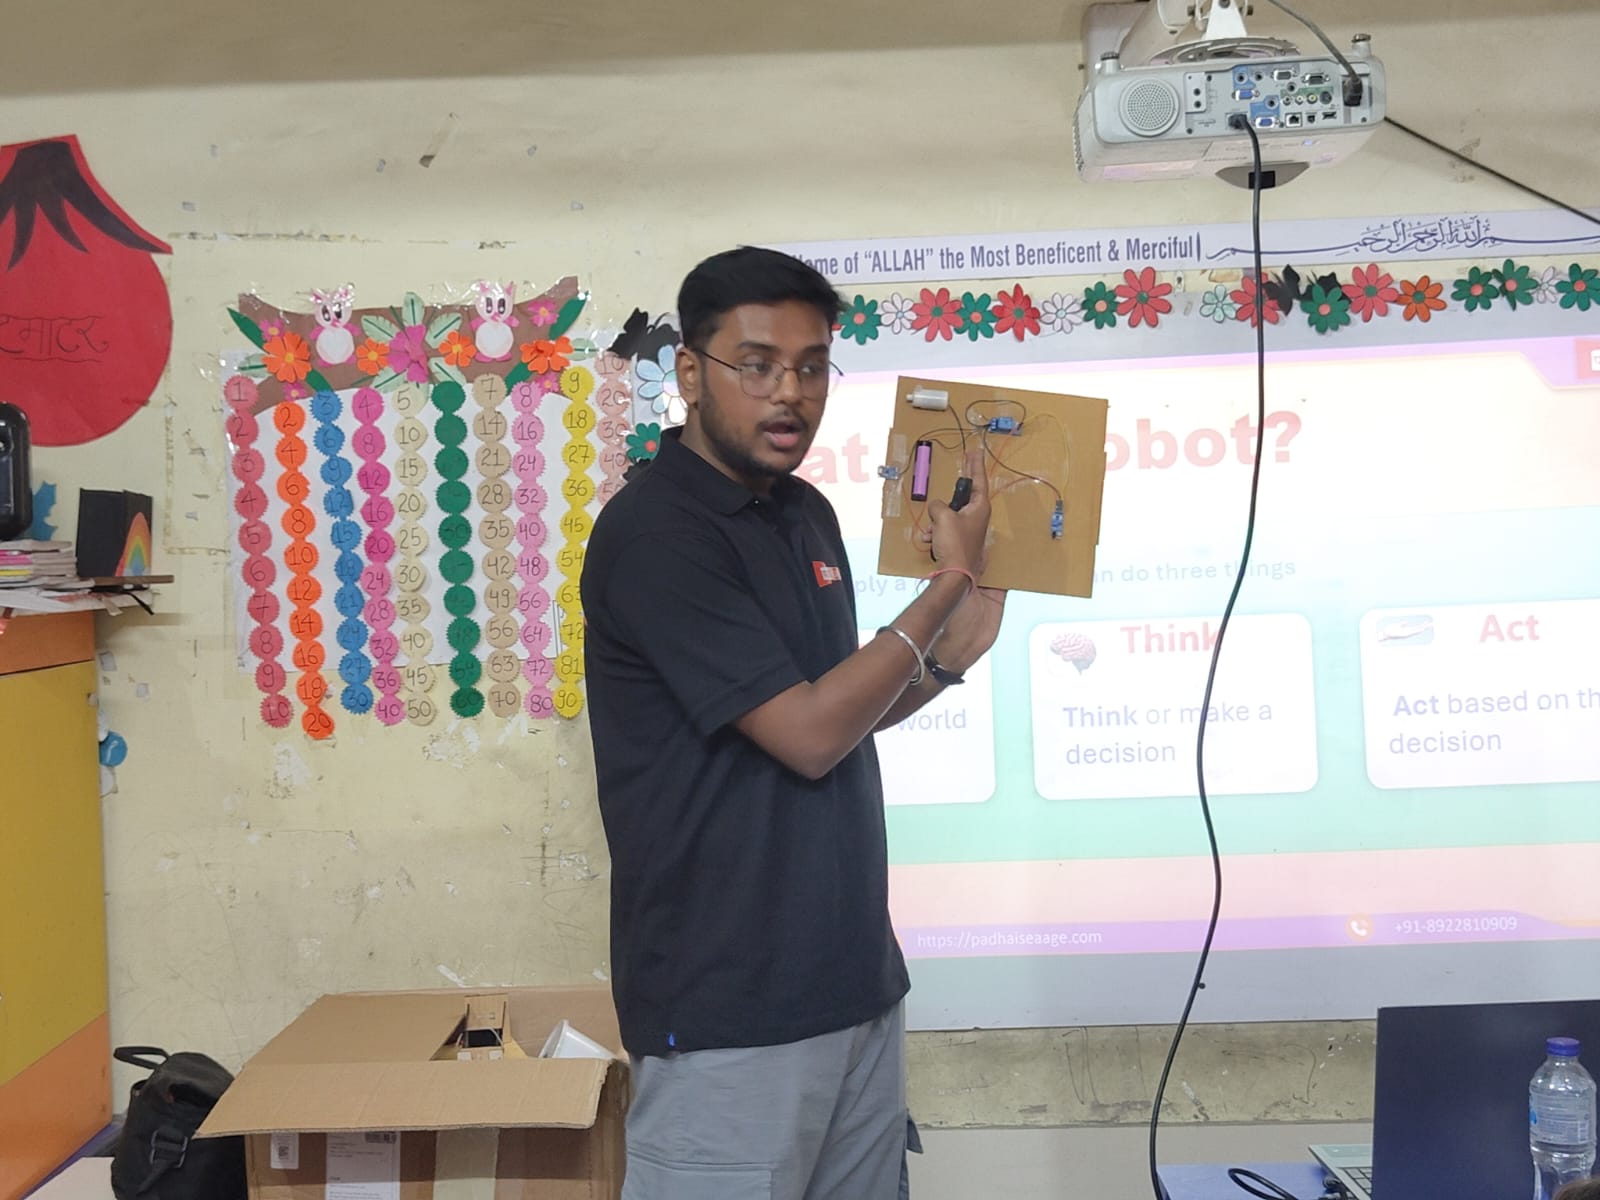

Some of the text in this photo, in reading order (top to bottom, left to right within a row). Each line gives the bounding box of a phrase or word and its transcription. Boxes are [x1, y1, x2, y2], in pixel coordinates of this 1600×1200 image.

[794, 253, 839, 275] ame
[844, 251, 859, 274] of
[940, 247, 965, 270] the
[970, 245, 1010, 268] Most
[1016, 242, 1101, 266] Beneficent
[1108, 240, 1120, 262] &
[1126, 235, 1193, 261] Merciful
[599, 351, 625, 375] 10
[232, 381, 248, 402] 1
[480, 378, 497, 400] 7
[568, 372, 580, 394] 9
[397, 388, 411, 410] 5
[520, 384, 532, 408] 8
[602, 388, 626, 407] 20
[279, 406, 296, 428] 2
[359, 395, 375, 419] 4
[231, 416, 248, 438] 2
[478, 416, 502, 436] 14
[566, 409, 588, 429] 18
[322, 428, 336, 448] 6
[400, 426, 420, 444] 10
[516, 422, 538, 441] 16
[602, 421, 628, 439] 30
[362, 432, 376, 455] 8
[1106, 410, 1302, 471] obot?
[280, 441, 298, 464] 4
[480, 448, 504, 466] 21
[568, 444, 590, 464] 27
[604, 452, 626, 472] 40
[238, 453, 255, 473] 3
[328, 458, 342, 482] 9
[400, 458, 419, 478] 15
[518, 456, 536, 476] 24
[286, 473, 300, 496] 6
[362, 470, 381, 490] 12
[566, 478, 588, 497] 36
[240, 490, 256, 512] 4
[330, 491, 349, 513] 12
[398, 492, 420, 513] 20
[480, 484, 504, 506] 28
[518, 488, 540, 505] 32
[292, 508, 306, 534] 8
[365, 502, 388, 523] 16
[245, 524, 260, 544] 5
[334, 523, 352, 544] 15
[486, 520, 510, 538] 35
[518, 522, 541, 540] 40
[563, 518, 584, 536] 45
[368, 537, 390, 555] 20
[400, 528, 422, 550] 25
[288, 547, 314, 566] 10
[520, 556, 542, 576] 48
[560, 551, 583, 568] 54
[250, 560, 266, 582] 6
[400, 566, 420, 585] 30
[487, 558, 511, 576] 42
[1121, 564, 1151, 582] do
[1156, 562, 1217, 581] three
[291, 579, 312, 601] 12
[366, 572, 384, 590] 24
[895, 578, 906, 591] a
[253, 594, 269, 620] 7
[398, 599, 422, 617] 35
[489, 588, 511, 609] 49
[519, 591, 542, 610] 56
[370, 600, 390, 623] 28
[293, 613, 314, 634] 14
[488, 619, 514, 638] 56
[562, 622, 584, 640] 72
[1479, 614, 1540, 643] Act
[259, 630, 273, 654] 8
[402, 632, 426, 653] 40
[523, 626, 543, 644] 64
[1119, 621, 1220, 654] Think
[298, 646, 320, 668] 16
[371, 638, 394, 659] 32
[490, 655, 515, 672] 63
[526, 658, 549, 676] 72
[560, 655, 584, 676] 81
[262, 664, 275, 688] 9
[374, 672, 397, 689] 36
[406, 666, 428, 685] 45
[298, 677, 323, 700] 18
[348, 688, 368, 708] 30
[491, 690, 517, 707] 70
[265, 701, 290, 721] 10
[378, 703, 400, 718] 40
[408, 701, 432, 719] 50
[530, 694, 554, 713] 80
[556, 692, 578, 710] 90
[1393, 695, 1440, 717] Act
[1447, 690, 1529, 715] based
[1536, 693, 1570, 711] on
[306, 712, 332, 733] 20
[900, 708, 968, 732] world
[1062, 701, 1273, 728] Think or make a
[1389, 730, 1503, 755] decision
[1065, 741, 1177, 765] decision
[1394, 916, 1518, 935] +91-8922810909
[917, 931, 1102, 949] https://padhaiseaage.com
